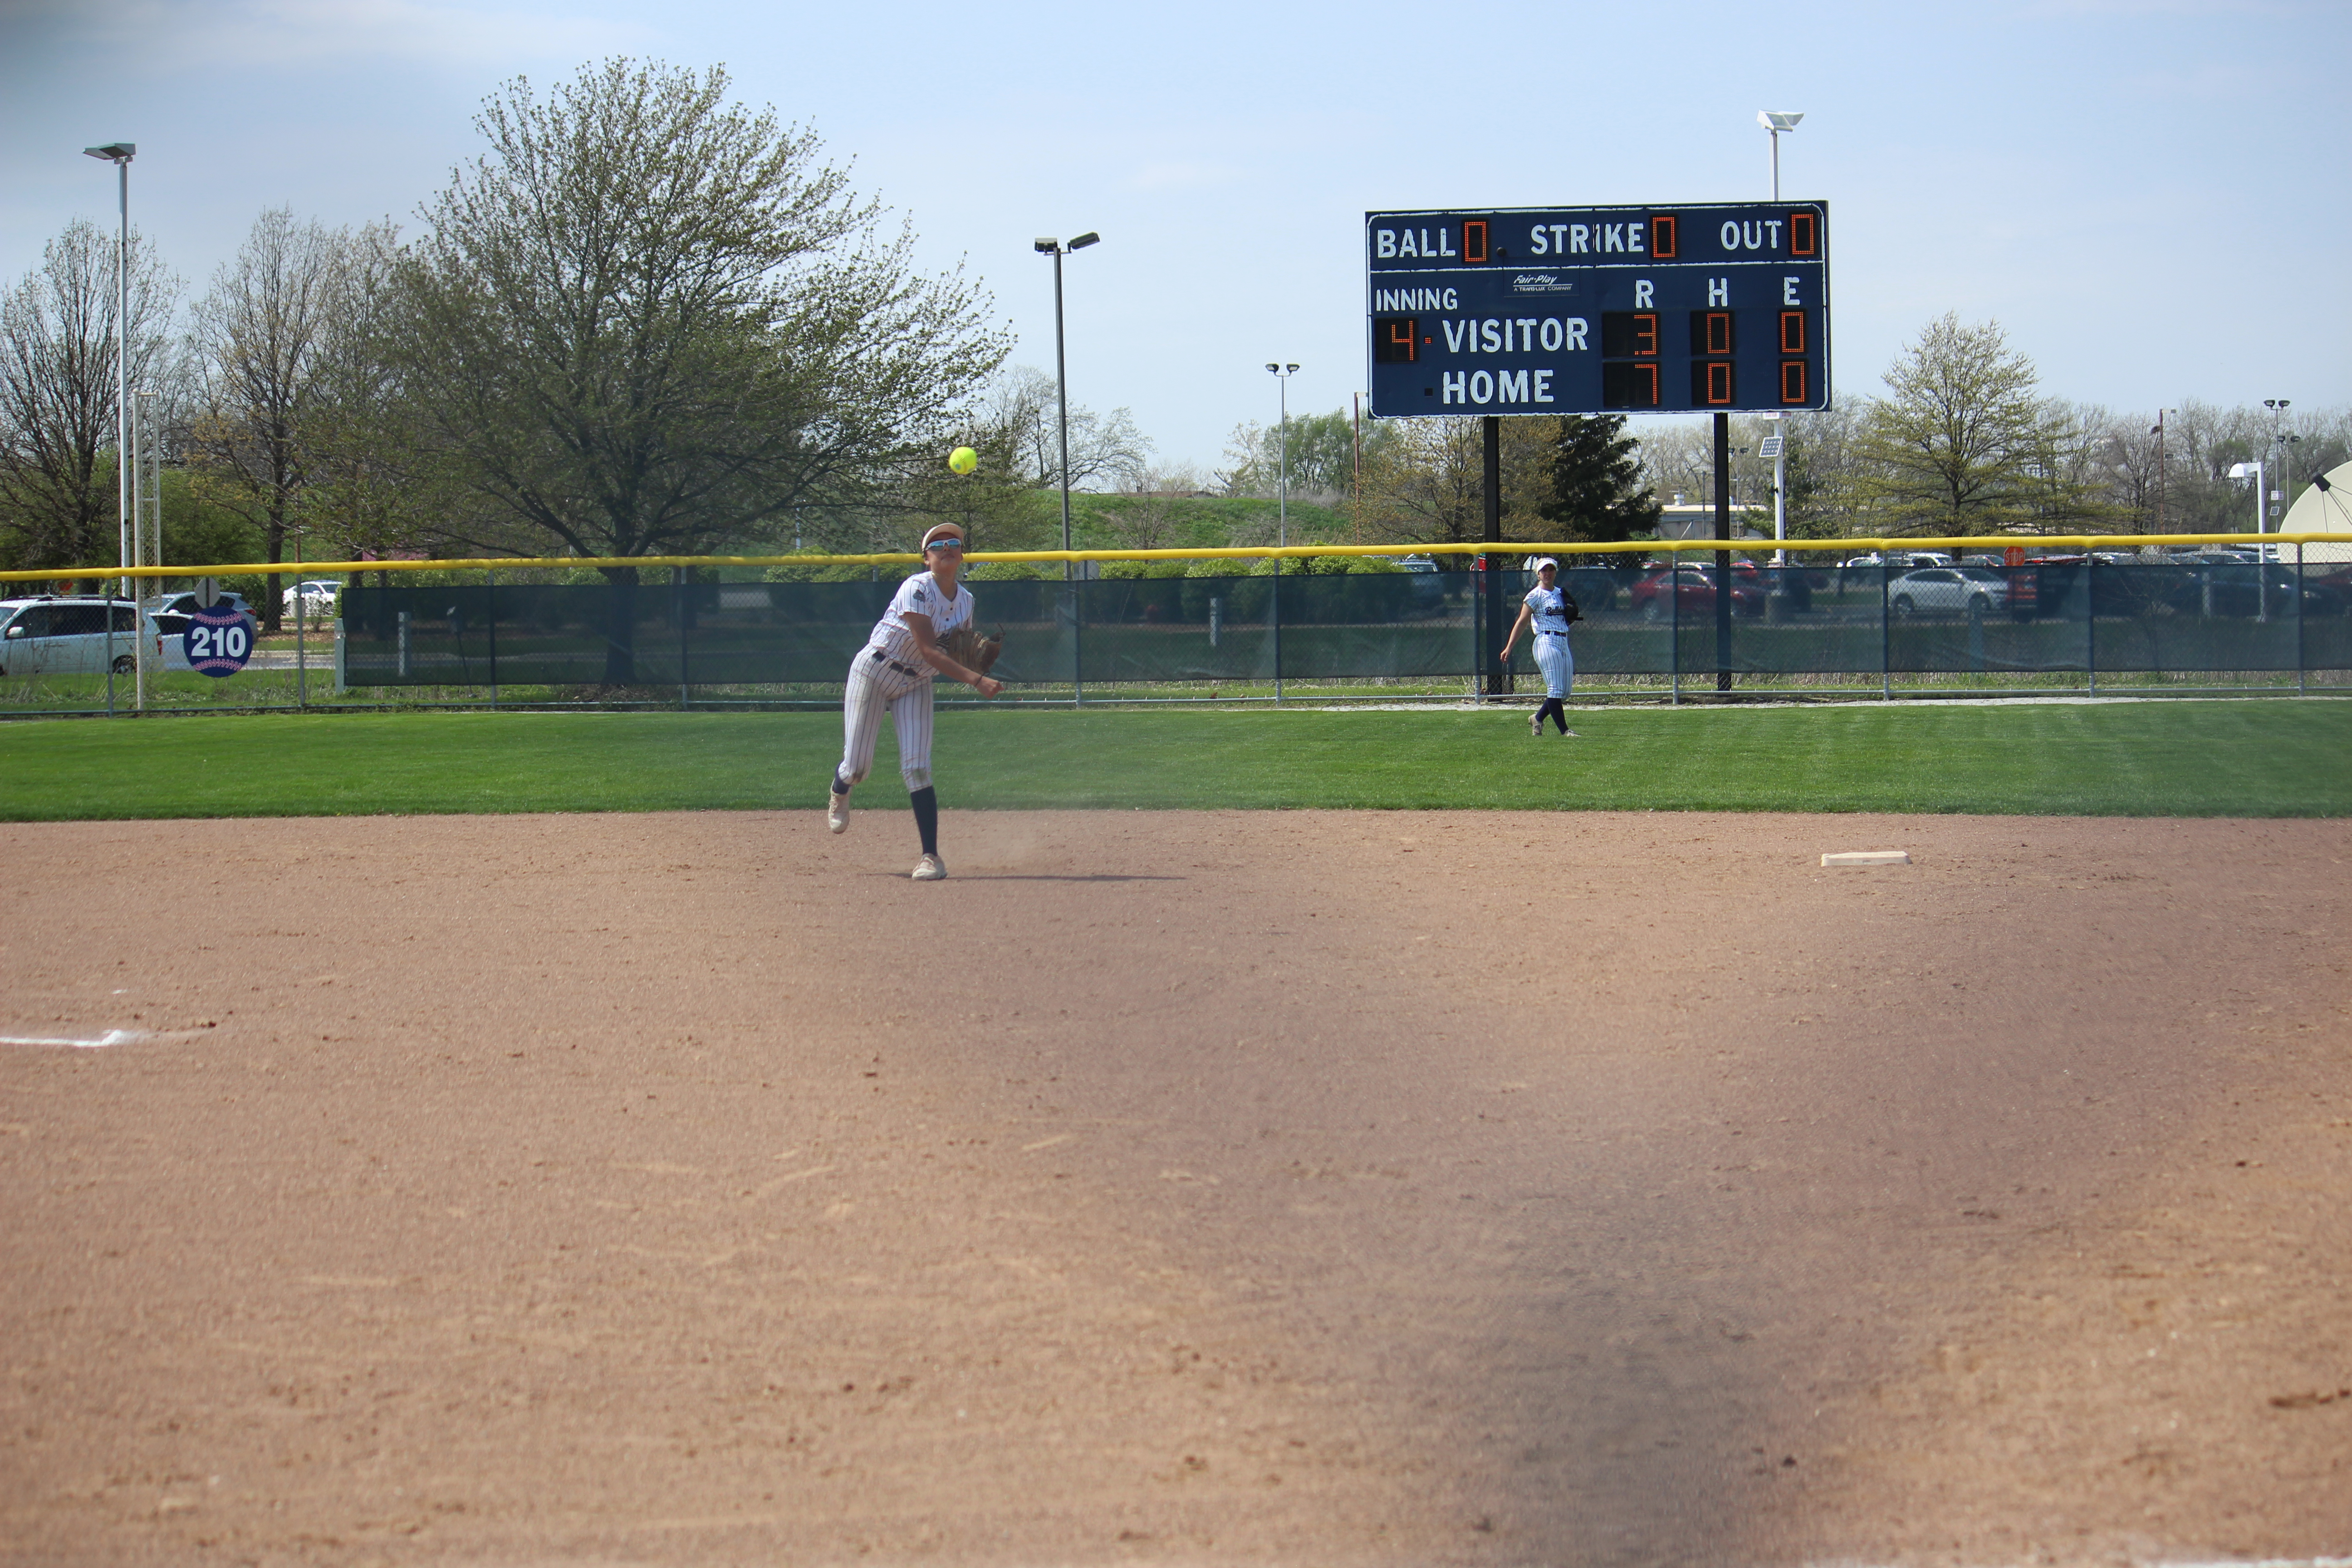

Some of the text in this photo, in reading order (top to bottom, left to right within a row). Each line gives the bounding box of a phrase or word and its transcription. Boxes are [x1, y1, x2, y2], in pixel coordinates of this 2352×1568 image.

[1377, 228, 1456, 258] BALL
[1465, 221, 1487, 262] 0
[1530, 223, 1644, 255] STRIKE
[1652, 217, 1676, 258] 0
[1720, 220, 1782, 250] OUT
[1791, 214, 1814, 255] 0
[1376, 288, 1458, 312] INNING
[1635, 279, 1654, 309] R
[1708, 278, 1728, 307] H
[1784, 276, 1800, 305] E
[1392, 320, 1414, 361] 4
[1442, 318, 1588, 353] VISITOR
[1634, 314, 1656, 355] 3
[1707, 313, 1729, 353] 0
[1781, 312, 1804, 353] 0
[1443, 369, 1554, 404] HOME
[1635, 364, 1657, 404] 7
[1708, 363, 1730, 403] 0
[1783, 362, 1805, 402] 0
[2005, 552, 2024, 563] STOP
[191, 627, 246, 657] 210
